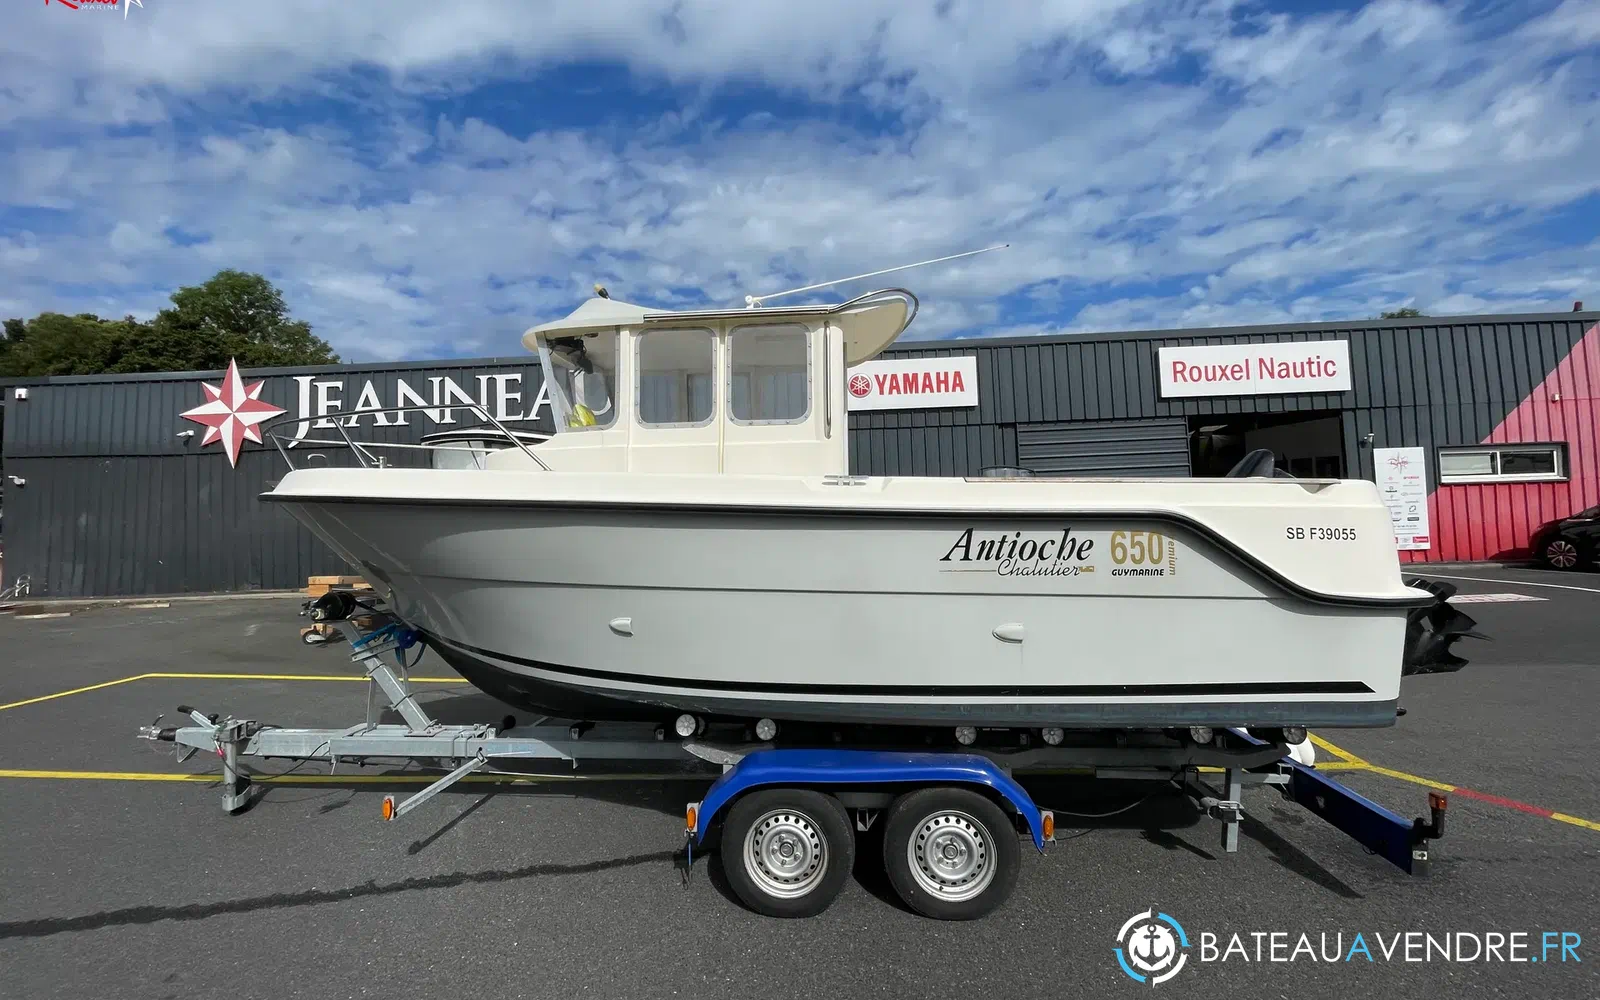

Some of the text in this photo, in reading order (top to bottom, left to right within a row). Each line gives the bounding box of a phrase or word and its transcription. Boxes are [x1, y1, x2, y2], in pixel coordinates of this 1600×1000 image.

[1172, 355, 1337, 383] Rouxel Nautic
[874, 371, 965, 396] YAMAHA
[939, 527, 1095, 562] Antioche
[1286, 527, 1357, 541] SB F39055
[1110, 530, 1164, 565] 650
[997, 558, 1081, 577] Chalutier
[1111, 568, 1165, 577] GUYMARINE
